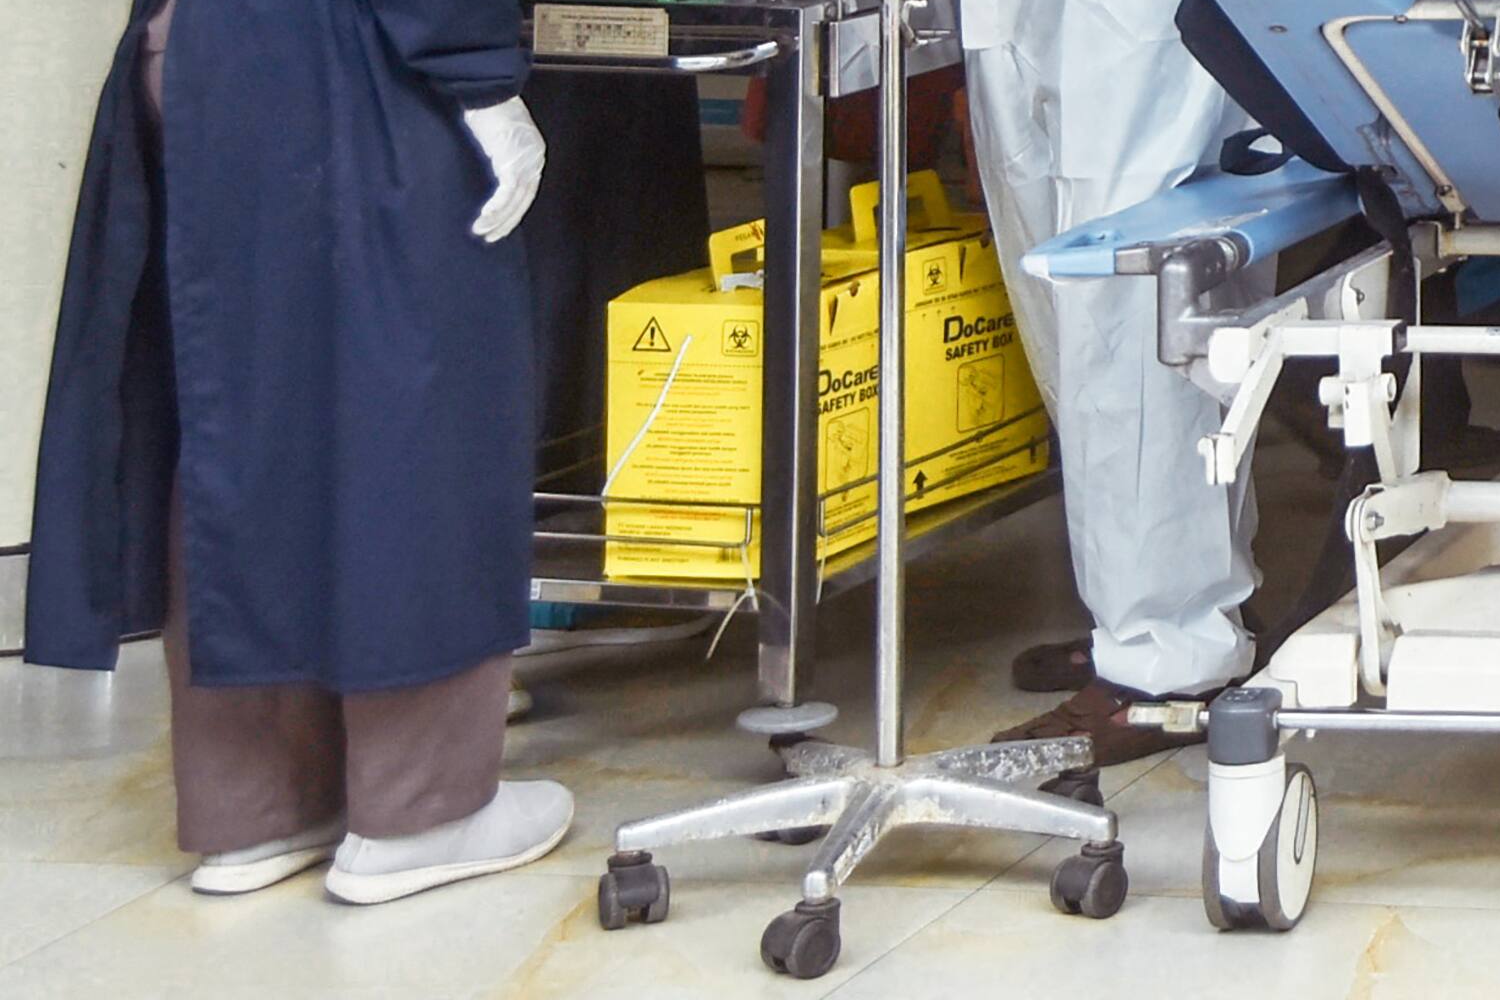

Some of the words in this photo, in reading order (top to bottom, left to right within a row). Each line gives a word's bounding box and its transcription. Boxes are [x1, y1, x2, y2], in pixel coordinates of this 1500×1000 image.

[942, 311, 1016, 344] DoCare
[945, 340, 989, 362] SAFETY
[991, 331, 1014, 349] BOX
[818, 364, 879, 397] DoCare
[858, 384, 879, 403] BOX
